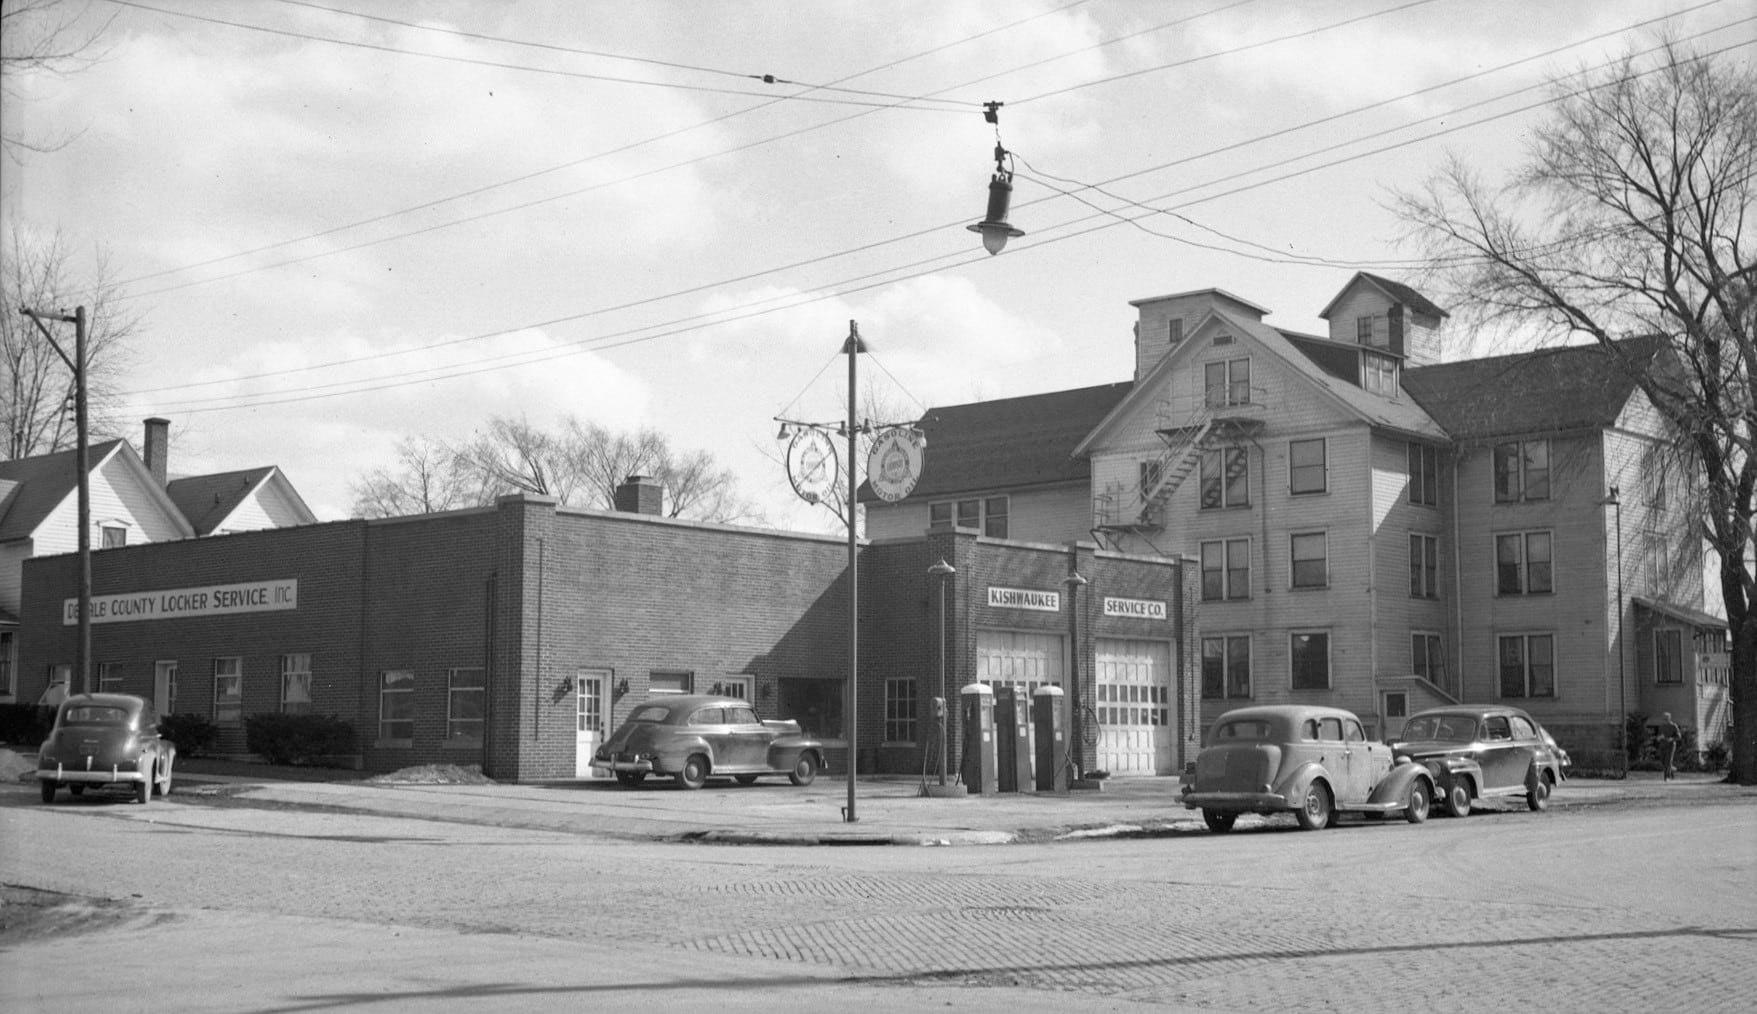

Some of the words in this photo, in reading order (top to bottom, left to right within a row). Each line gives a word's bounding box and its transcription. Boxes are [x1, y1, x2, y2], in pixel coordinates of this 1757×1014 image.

[872, 430, 920, 455] GASOLINE
[872, 480, 901, 501] MOTOR
[904, 477, 920, 494] OIL
[68, 601, 107, 619] DEALB
[111, 597, 156, 616] COUNTY
[161, 593, 208, 612] LOCKER
[991, 590, 1057, 607] KISHWAUKEE
[1106, 600, 1146, 615] SERVICE
[1147, 602, 1164, 616] CO.
